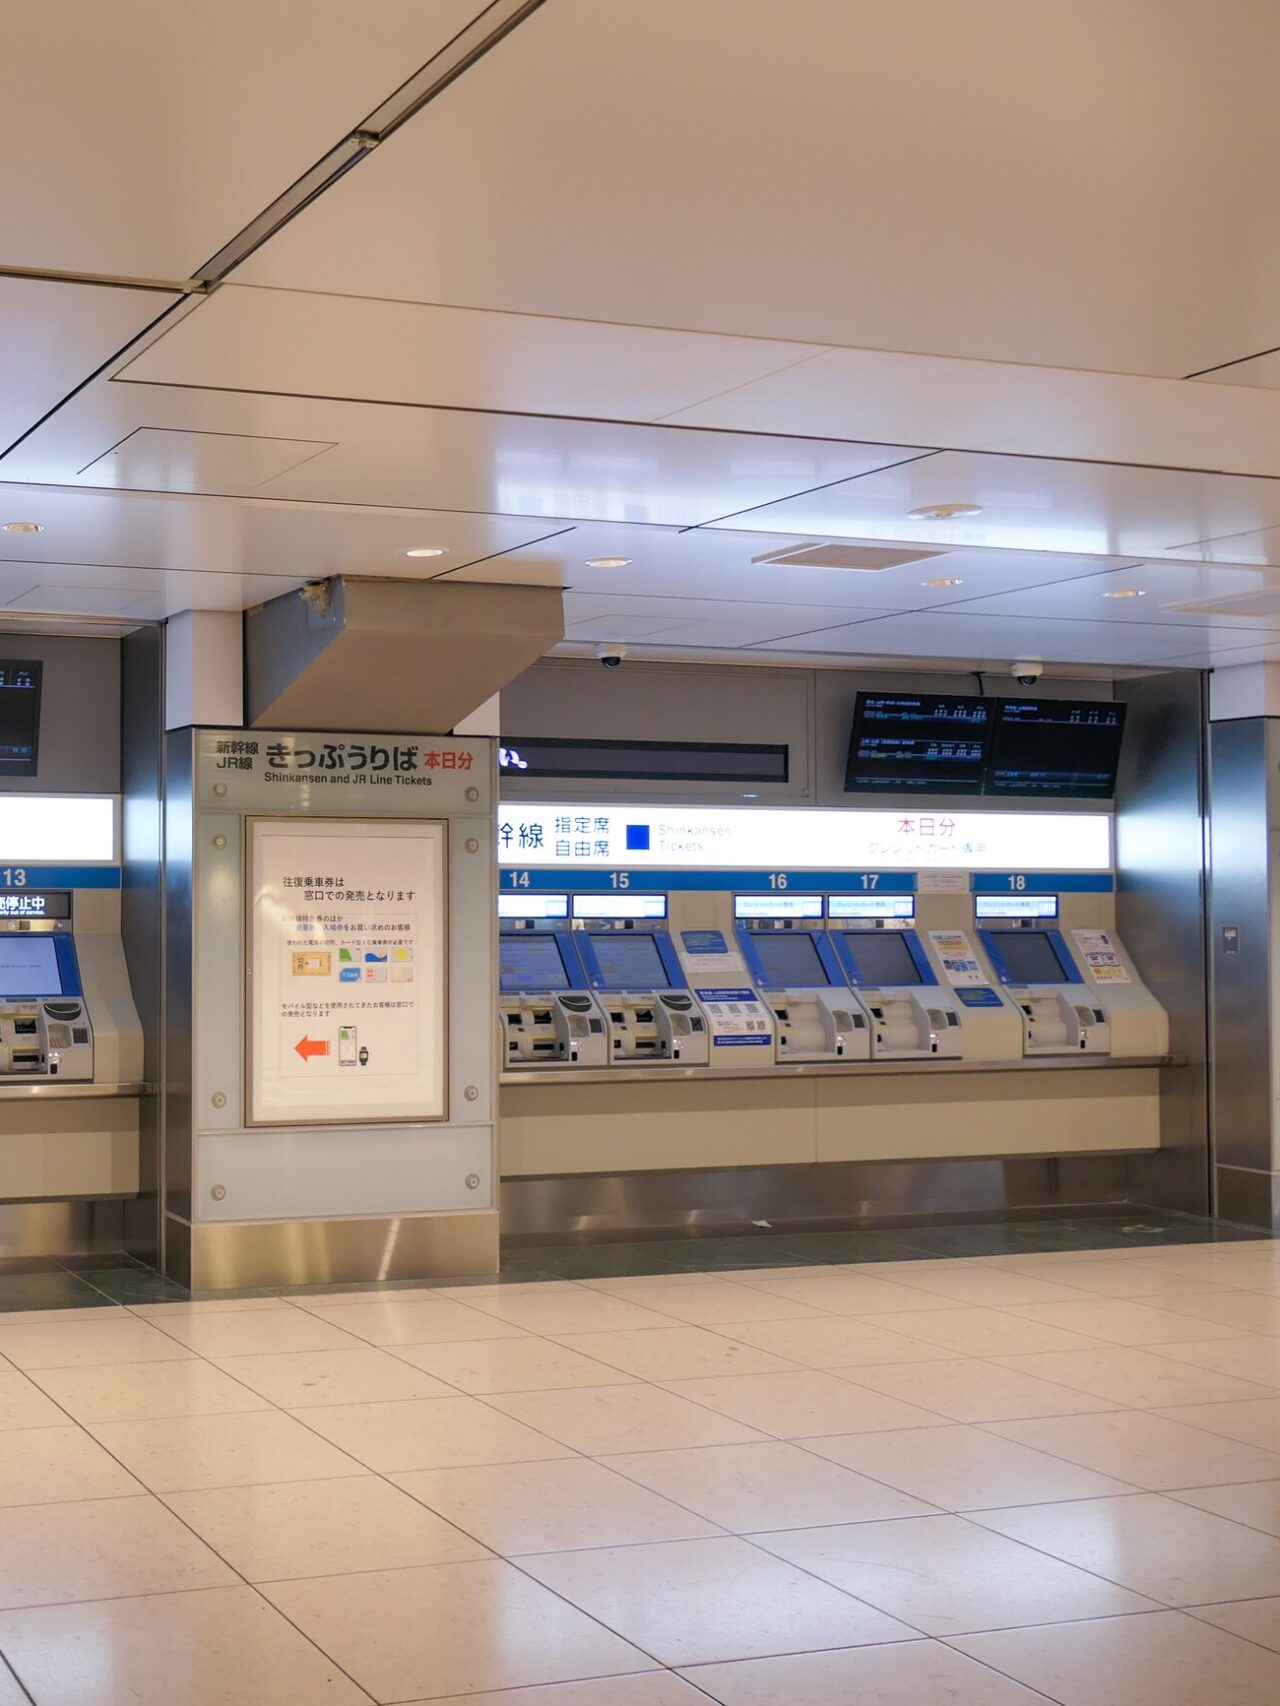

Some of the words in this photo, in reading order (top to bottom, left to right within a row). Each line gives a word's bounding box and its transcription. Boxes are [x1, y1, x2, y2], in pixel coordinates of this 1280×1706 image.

[216, 741, 259, 755] 新幹線
[216, 756, 253, 770] JR線
[266, 745, 418, 771] きっぷうりば
[424, 752, 473, 770] 本日分
[264, 772, 327, 783] Shinkansen
[330, 773, 350, 784] and
[352, 774, 367, 784] JR
[370, 774, 393, 785] Line
[395, 775, 432, 786] Tickets
[555, 816, 609, 834] 指定席
[898, 817, 955, 837] 本日分
[555, 840, 609, 857] 自由席
[3, 869, 26, 887] 13
[283, 877, 344, 888] 往復乗車券は
[509, 871, 530, 887] 14
[609, 872, 629, 888] 15
[768, 874, 787, 889] 16
[860, 875, 879, 890] 17
[1008, 875, 1025, 891] 18
[304, 890, 415, 901] 窓口での発売となります
